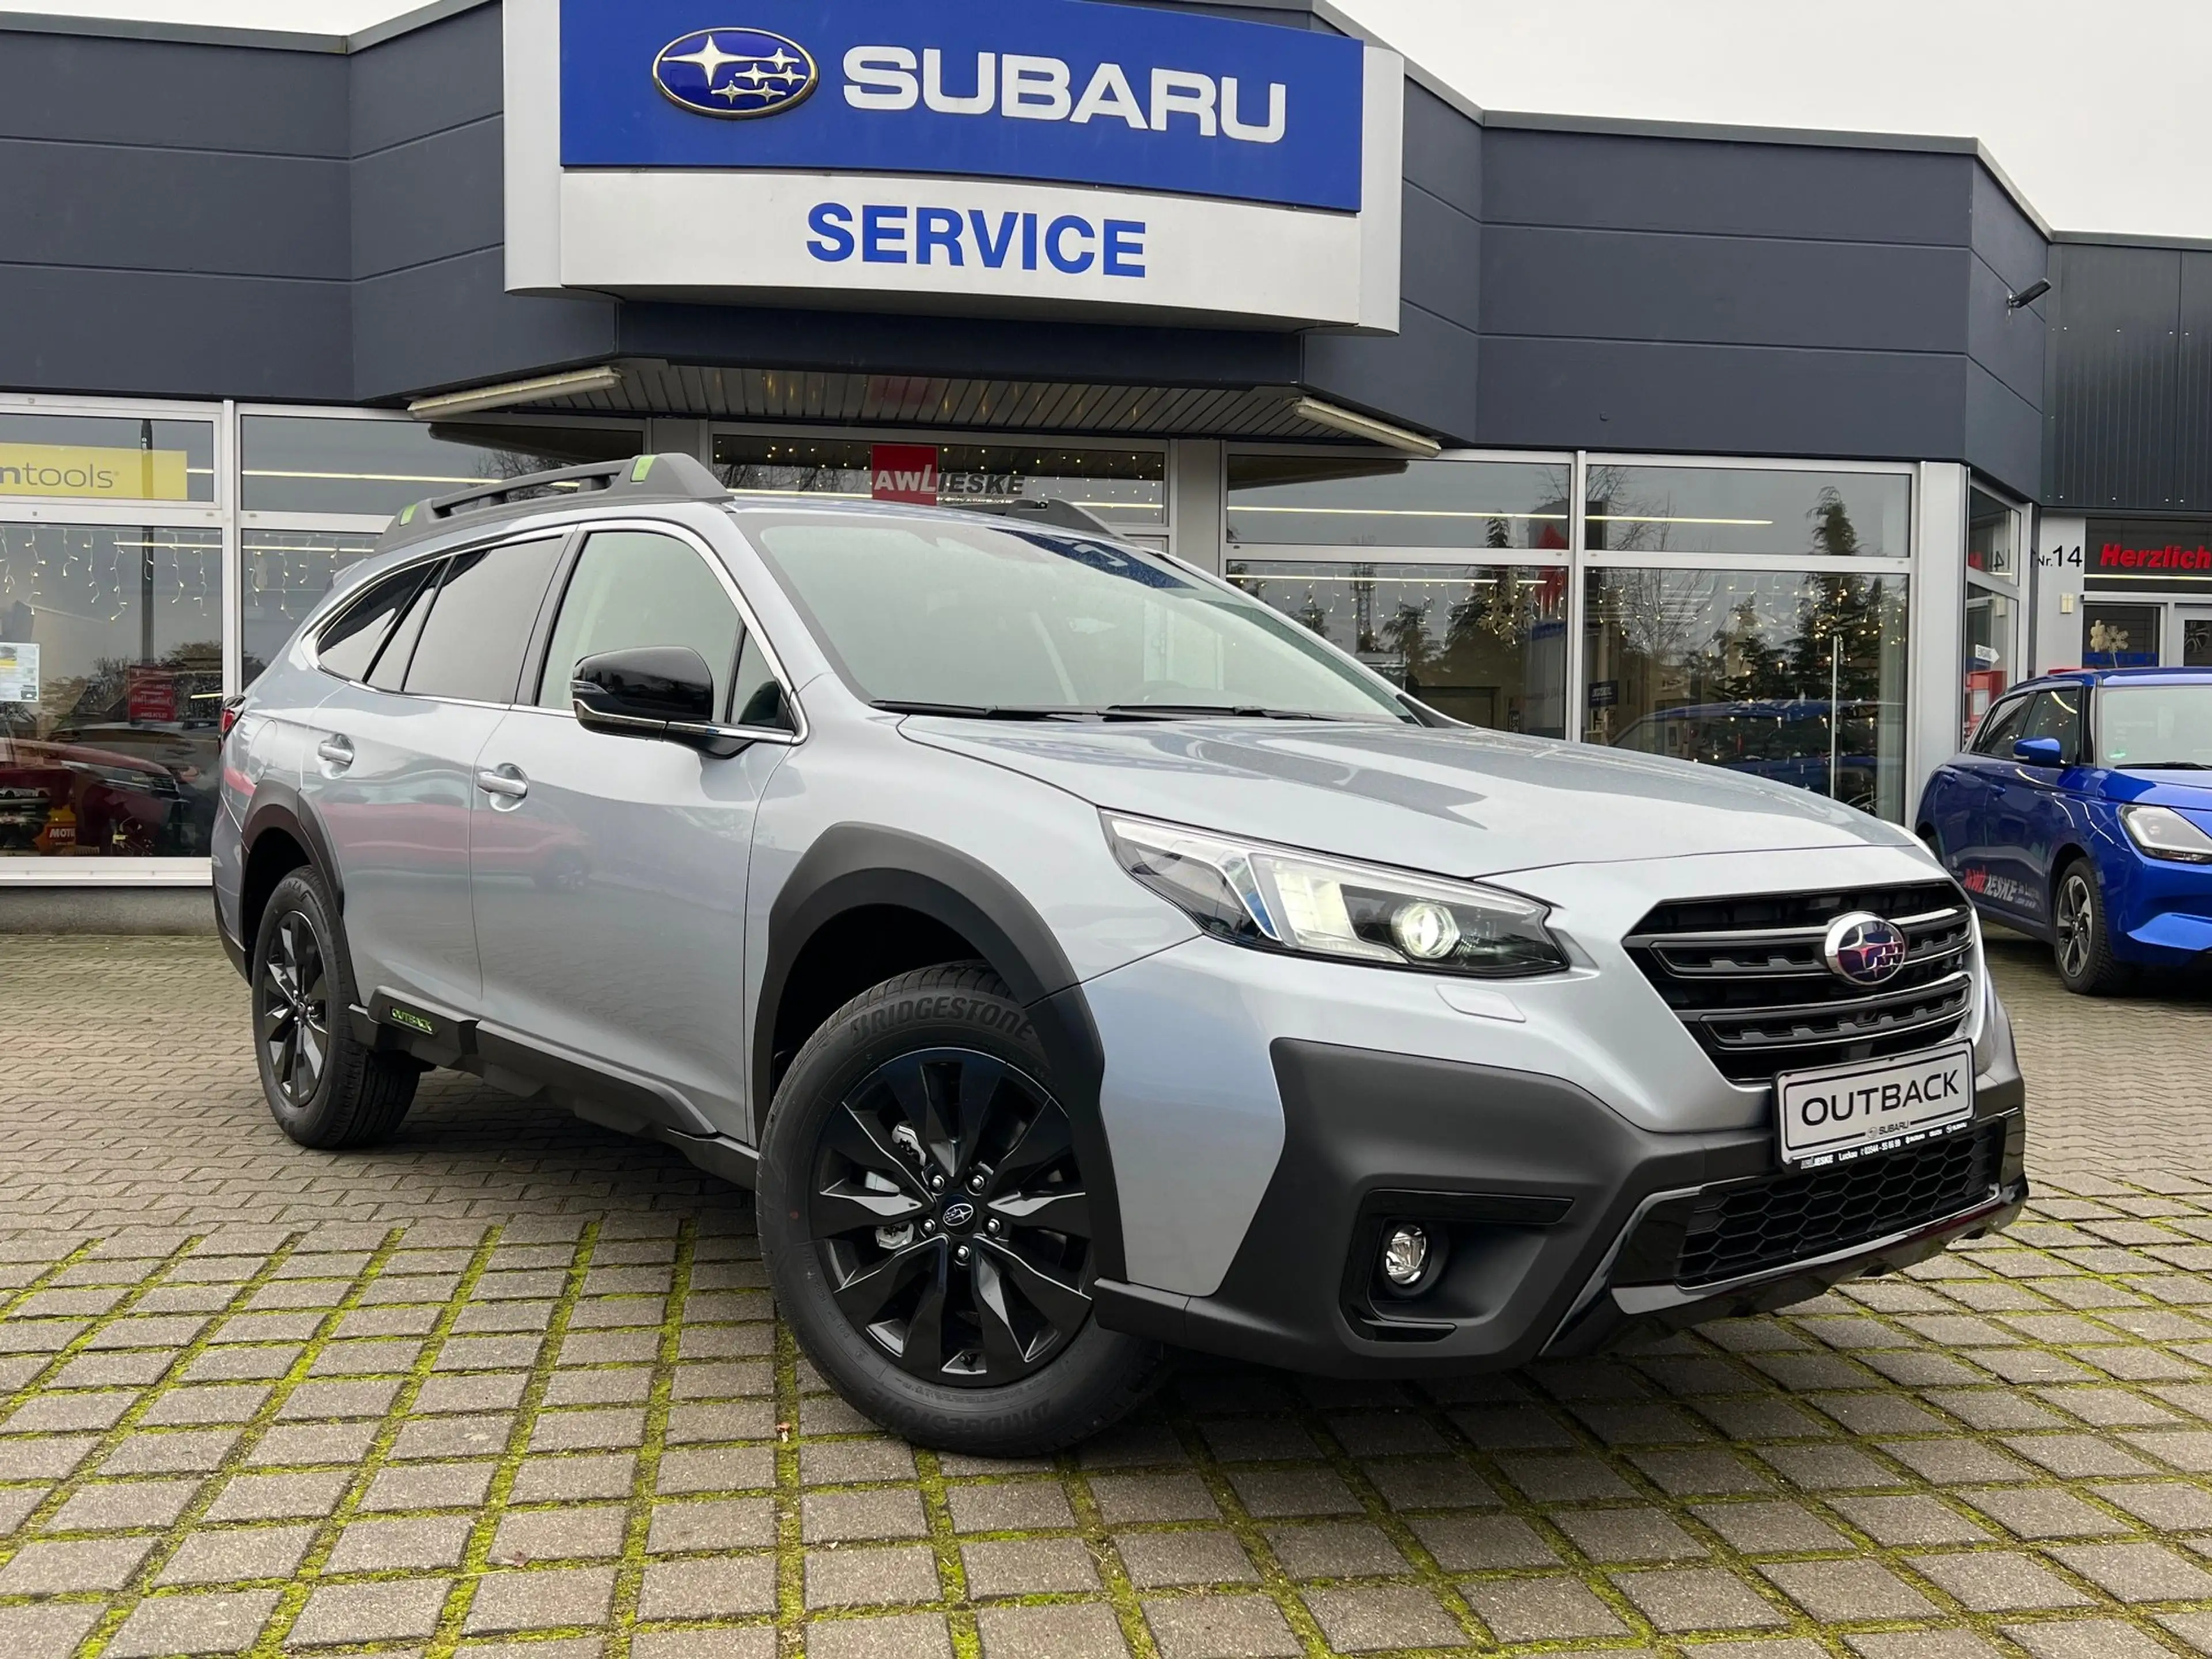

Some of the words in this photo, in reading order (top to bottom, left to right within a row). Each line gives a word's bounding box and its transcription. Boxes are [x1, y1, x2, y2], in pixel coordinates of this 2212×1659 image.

[842, 45, 1286, 144] SUBARU
[806, 202, 1147, 278] SERVICE
[2100, 543, 2212, 569] Herzlich
[392, 1007, 433, 1031] OUTBACK
[850, 996, 1035, 1046] BRIDGESTONE
[1801, 1069, 1960, 1126] OUTBACK
[1878, 1120, 1909, 1135] SUBARU
